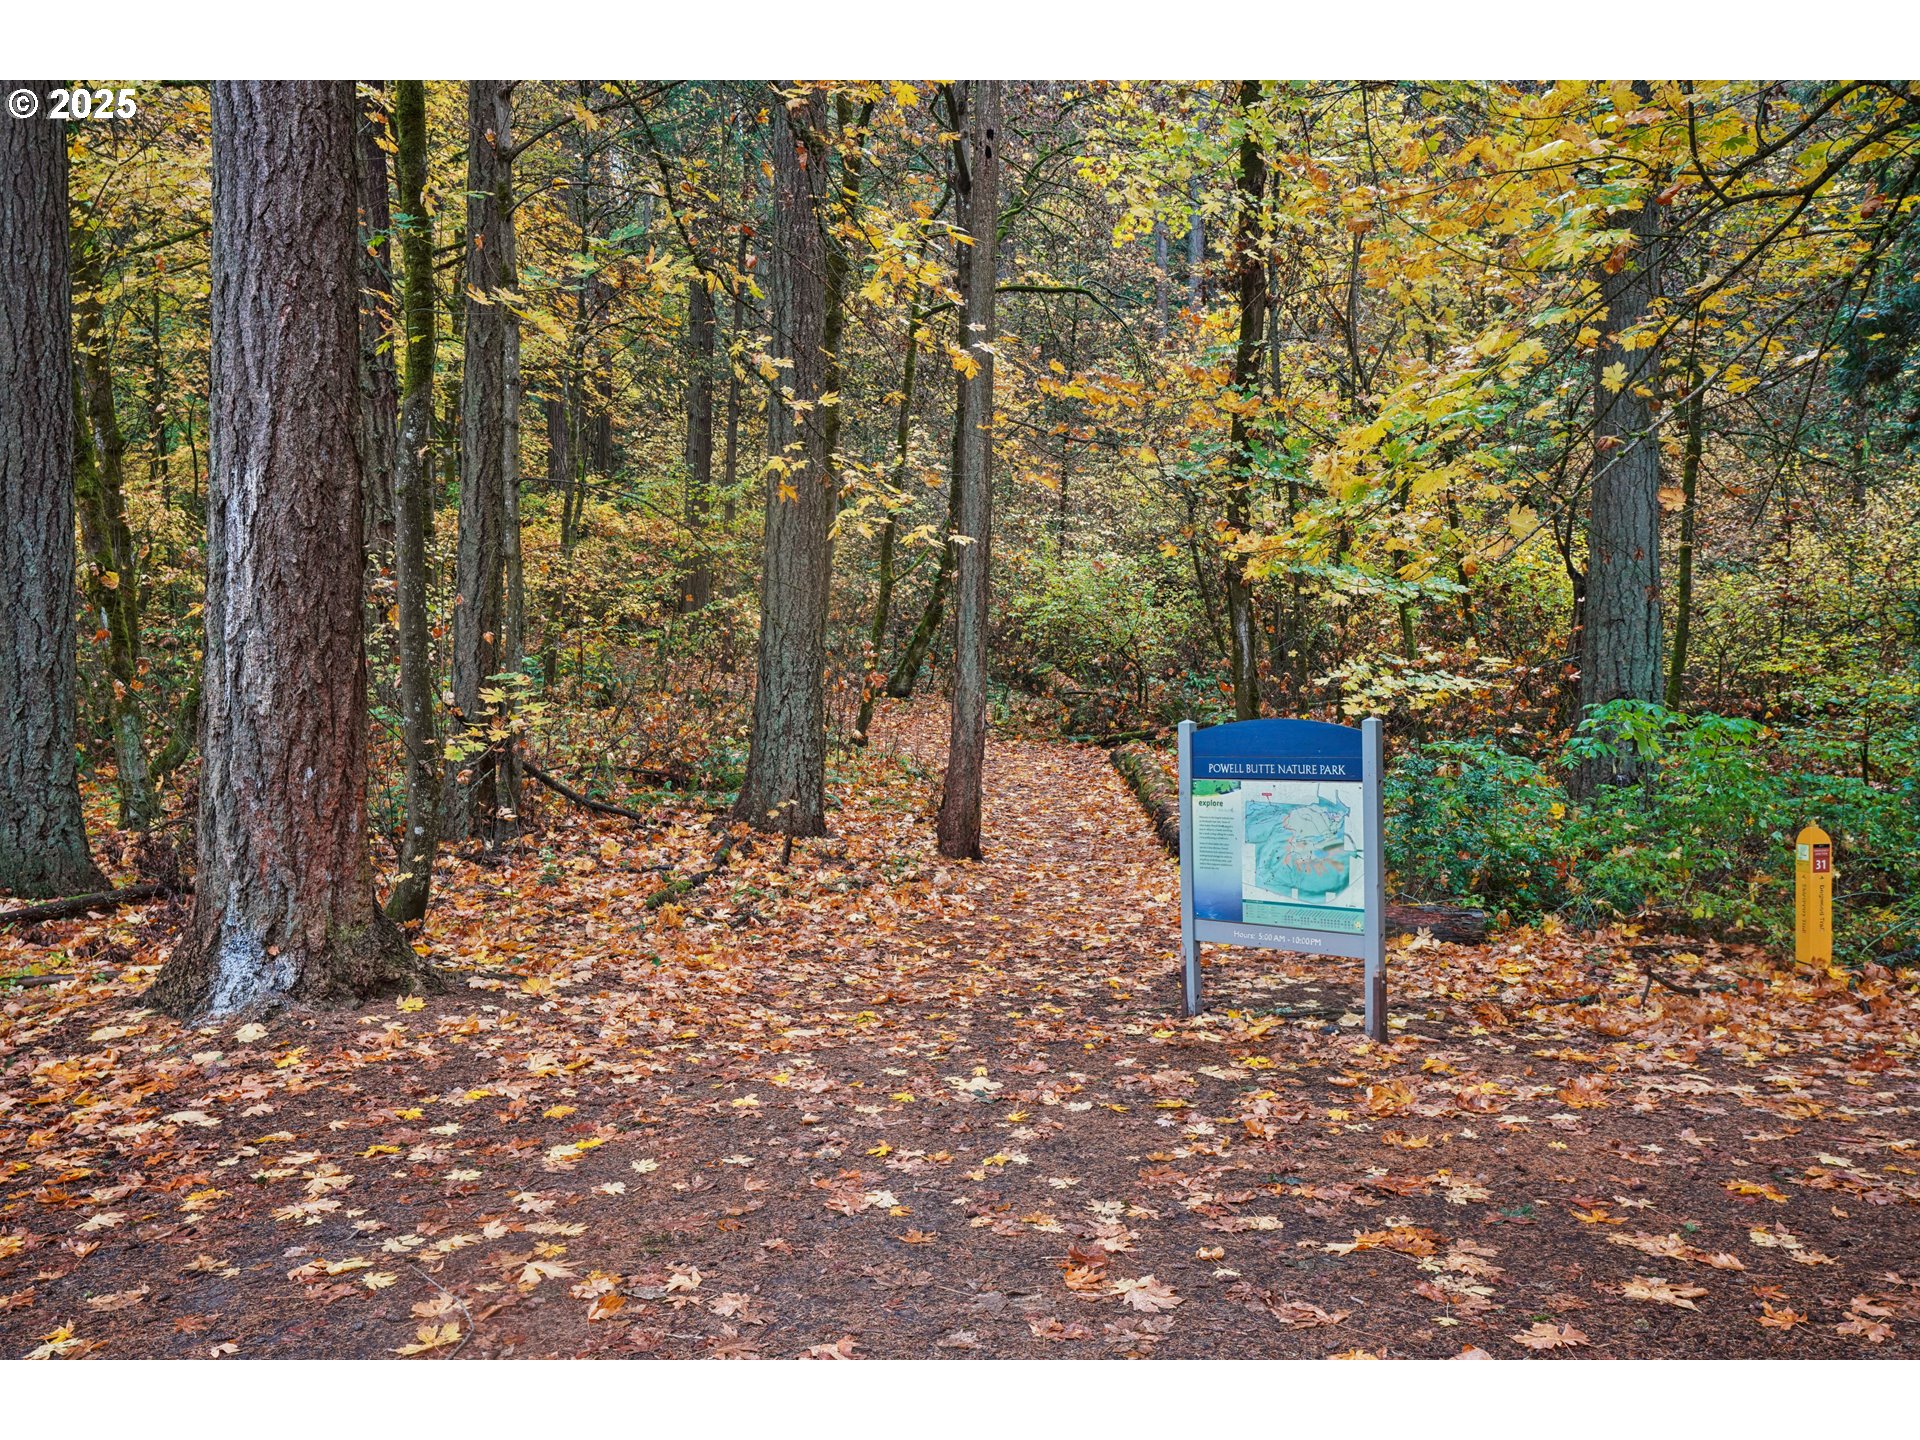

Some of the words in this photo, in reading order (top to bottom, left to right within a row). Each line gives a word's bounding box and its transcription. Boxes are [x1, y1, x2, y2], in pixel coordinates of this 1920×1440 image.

[1208, 763, 1245, 774] POWELL
[1246, 763, 1276, 774] BUTTE
[1278, 764, 1318, 775] NATURE
[1320, 764, 1346, 776] PARK
[1198, 799, 1224, 808] explore
[1815, 859, 1826, 870] 31
[1233, 930, 1256, 939] Hours:
[1258, 932, 1273, 941] 5:00
[1273, 934, 1286, 942] AM
[1292, 936, 1310, 945] 10:00
[1310, 938, 1322, 946] PM
